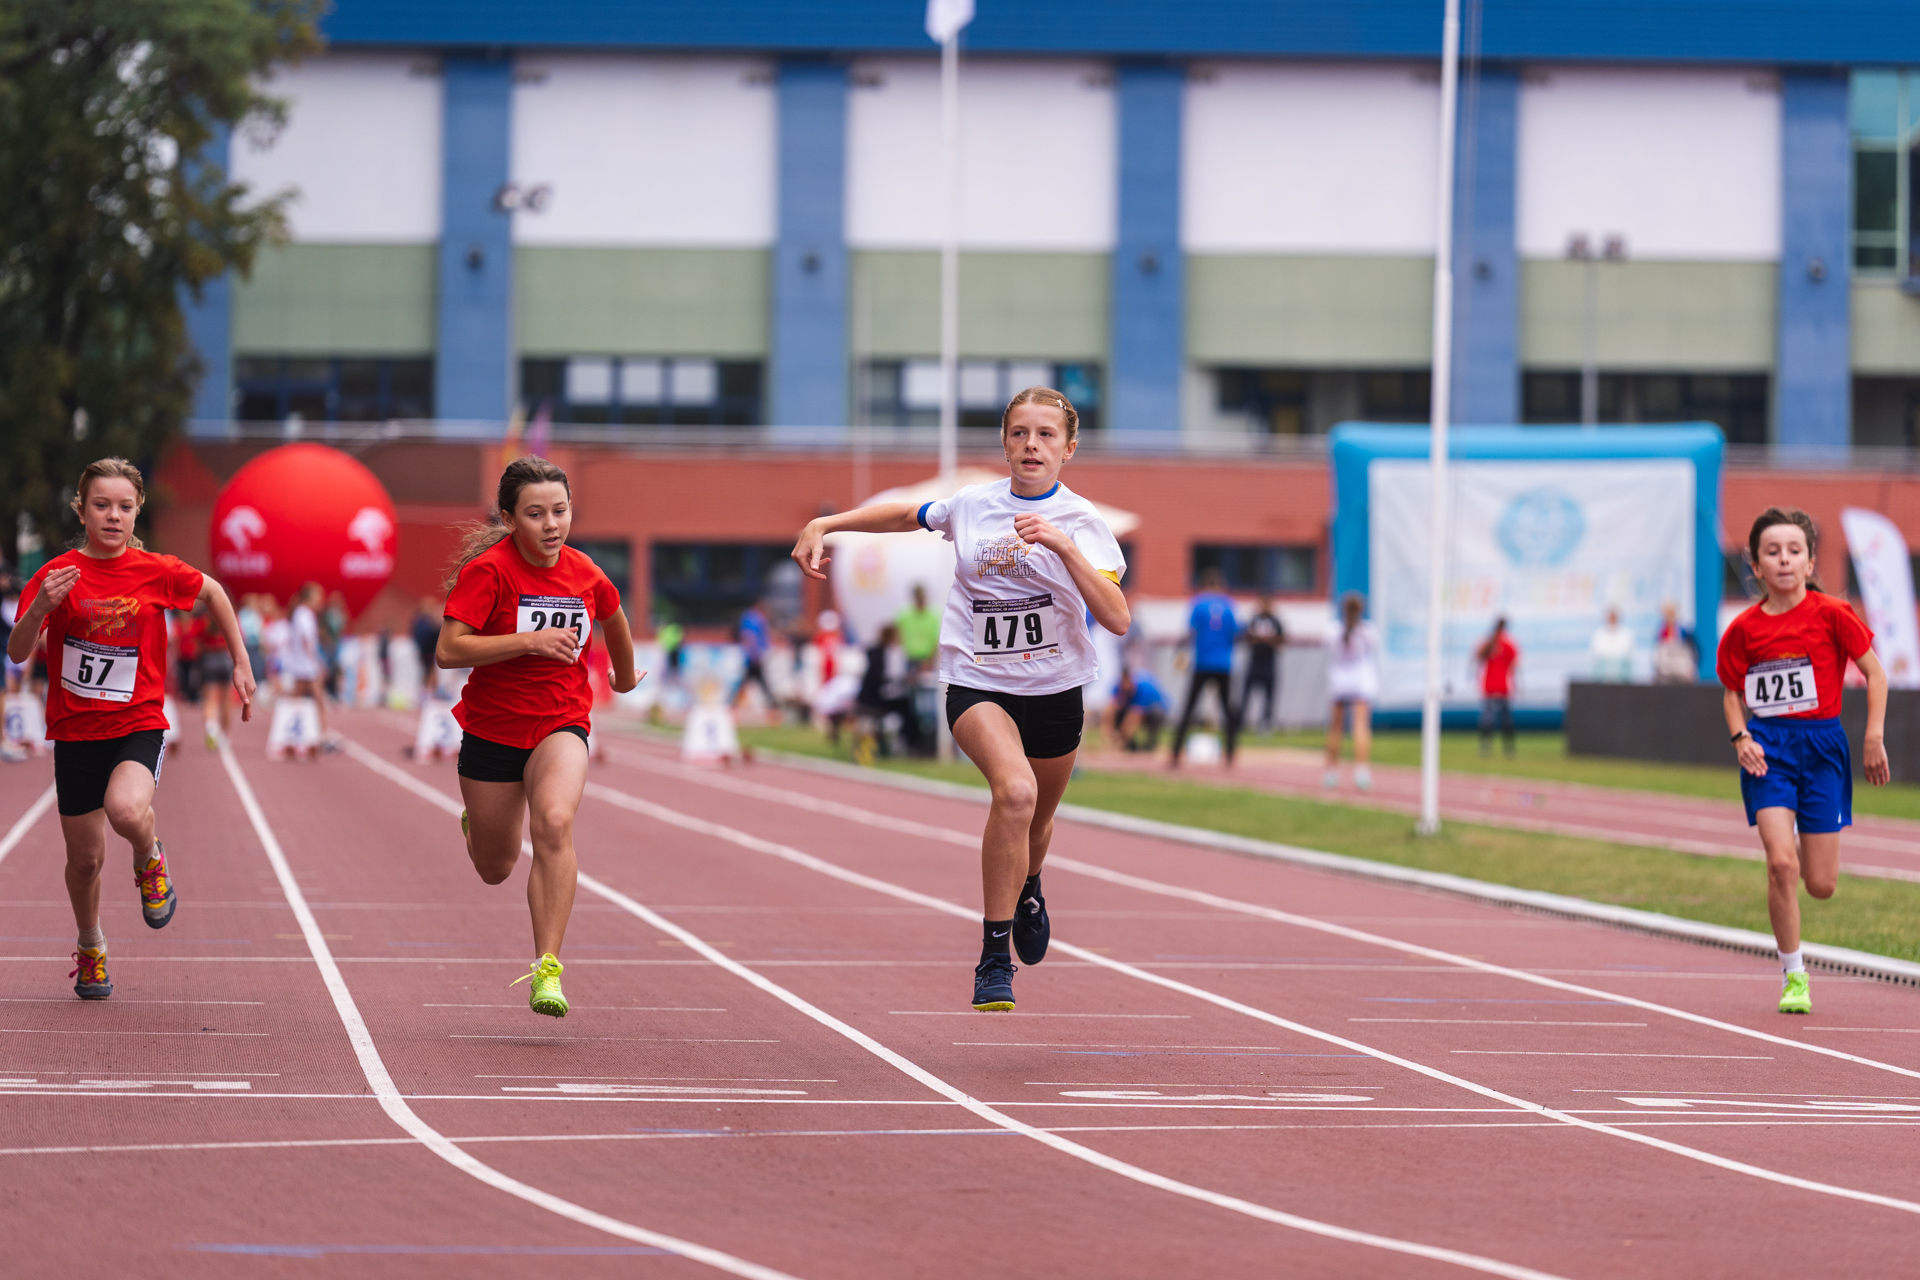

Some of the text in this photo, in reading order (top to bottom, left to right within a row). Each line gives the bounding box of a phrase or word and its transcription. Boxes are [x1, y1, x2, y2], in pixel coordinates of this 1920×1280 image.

[984, 613, 1043, 649] 479
[78, 654, 115, 686] 57
[1756, 671, 1804, 703] 425
